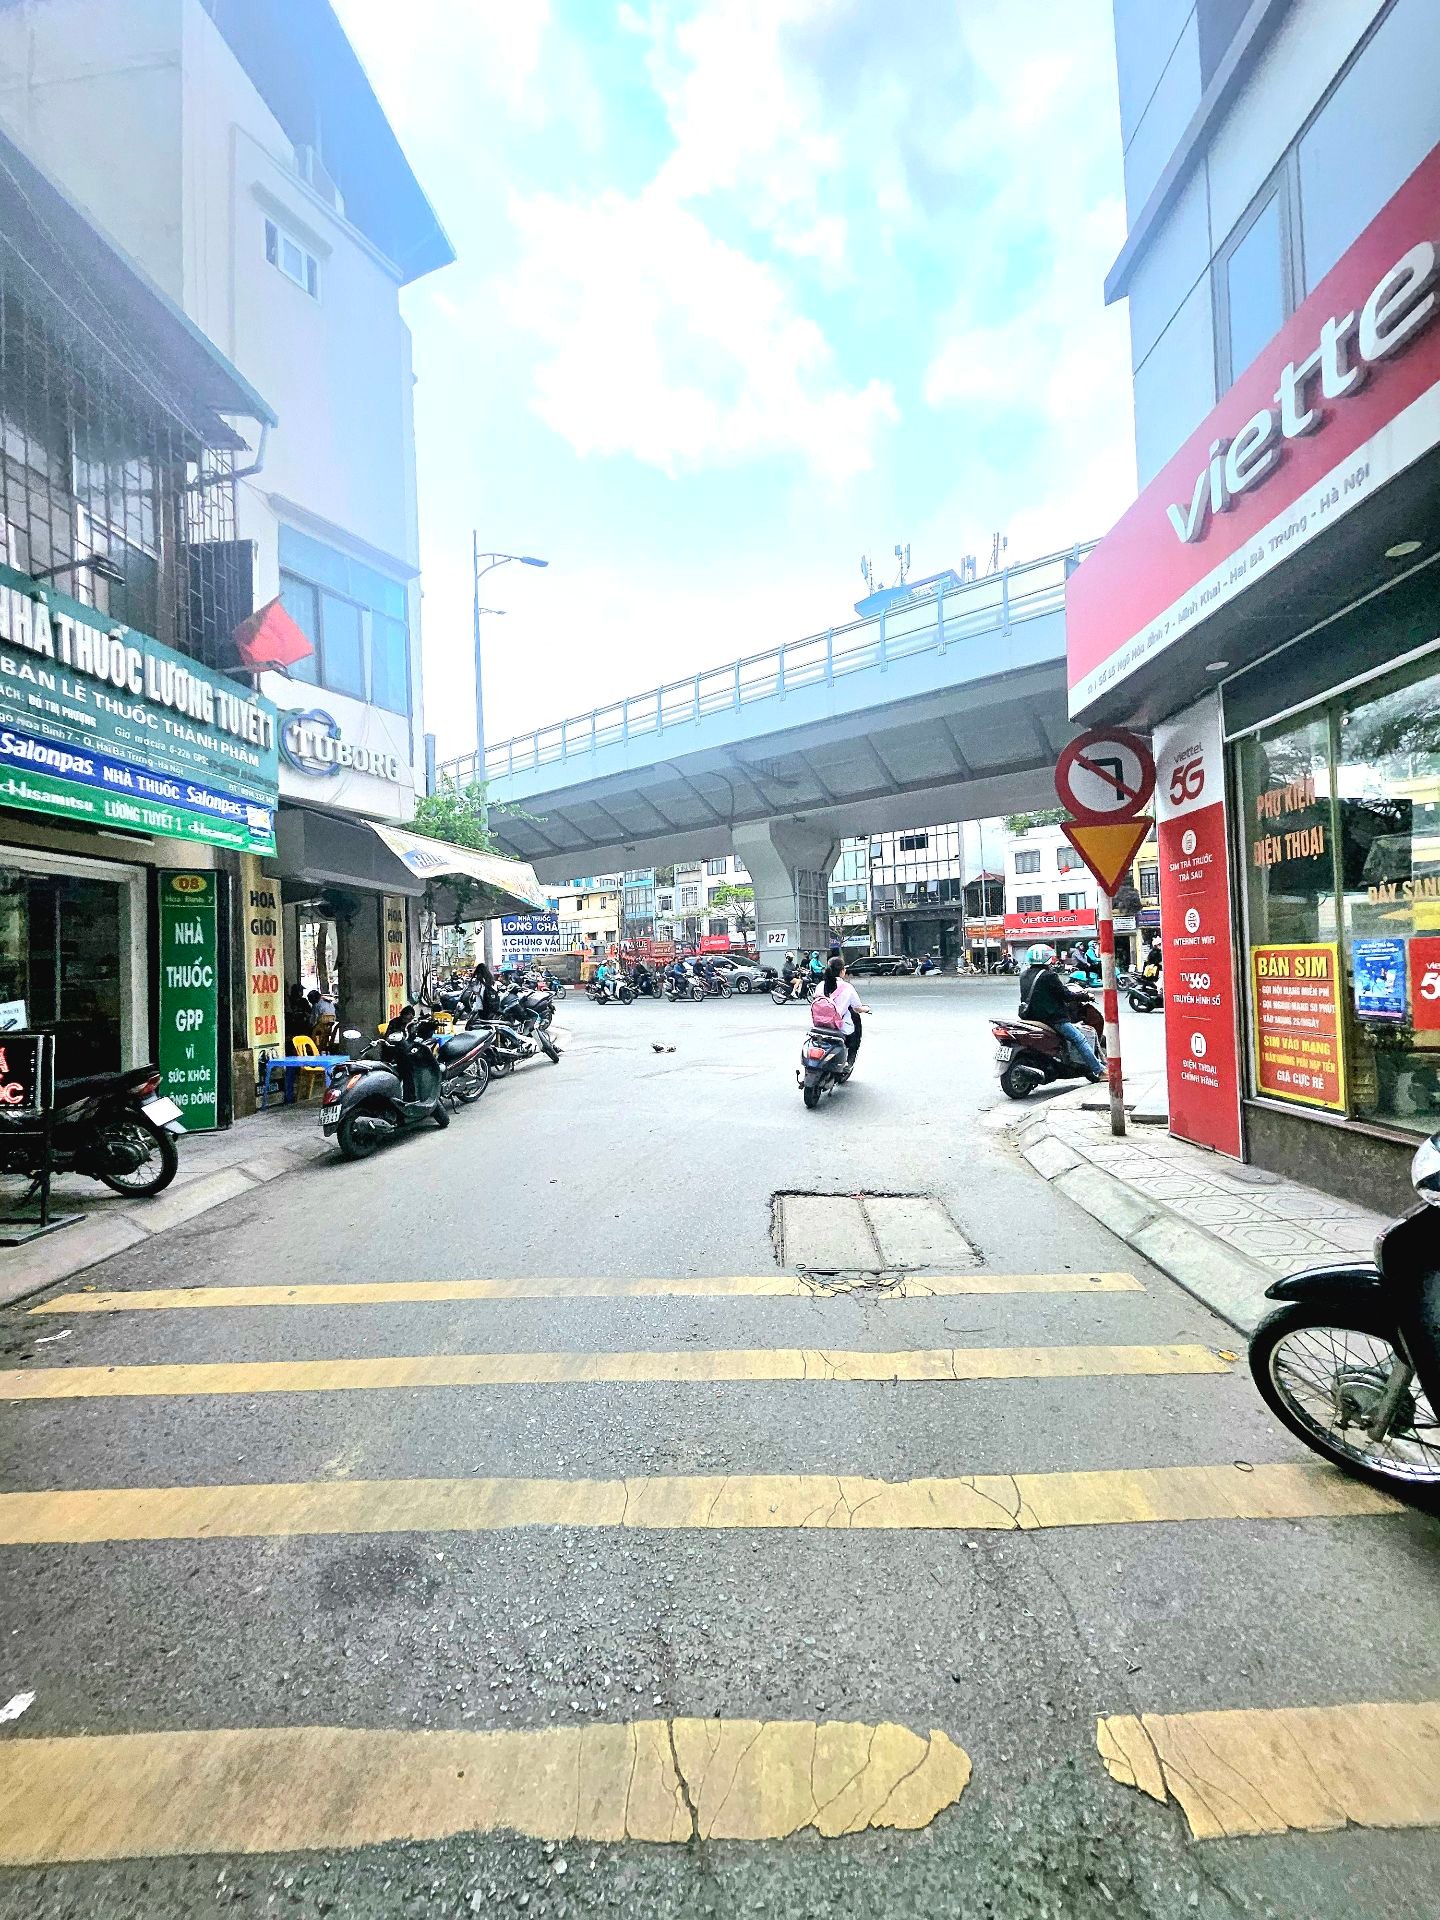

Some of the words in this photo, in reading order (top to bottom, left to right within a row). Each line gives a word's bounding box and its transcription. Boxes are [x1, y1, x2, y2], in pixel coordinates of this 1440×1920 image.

[1250, 546, 1264, 568] Bà
[1320, 487, 1340, 514] Hà
[54, 612, 143, 694] THUỐC
[144, 655, 215, 724] LƯƠNG
[62, 679, 87, 703] LẺ
[92, 691, 159, 730] THUỐC
[162, 719, 218, 752] THÀNH
[220, 743, 260, 767] PHẨM
[293, 725, 400, 781] TUBORG
[1173, 742, 1205, 764] viettel
[0, 732, 95, 776] Salonpas
[103, 765, 134, 787] NHÀ
[136, 775, 180, 800] THUỐC
[186, 786, 242, 815] Salonpas
[1169, 756, 1205, 806] 5G
[1190, 869, 1204, 881] SAU
[250, 890, 277, 909] HOA
[1402, 877, 1440, 902] SAN
[175, 916, 204, 945] NHÀ
[503, 921, 533, 932] LONG
[1020, 914, 1057, 925] viettel
[1058, 914, 1078, 924] post
[768, 933, 786, 944] P27
[1173, 936, 1200, 946] INTERNET
[1201, 935, 1216, 945] WIFI
[166, 956, 213, 988] THUỐC
[1258, 953, 1290, 976] BÁN
[1294, 956, 1328, 977] SIM
[253, 971, 279, 995] XÀO
[1180, 972, 1211, 990] TV360
[1420, 972, 1440, 1000] 5
[175, 1009, 204, 1032] GPP
[254, 1015, 278, 1036] BIA
[1263, 1035, 1280, 1048] SIM
[1282, 1036, 1300, 1051] VÀO
[1301, 1040, 1331, 1056] MẠNG
[168, 1067, 186, 1083] SỨC
